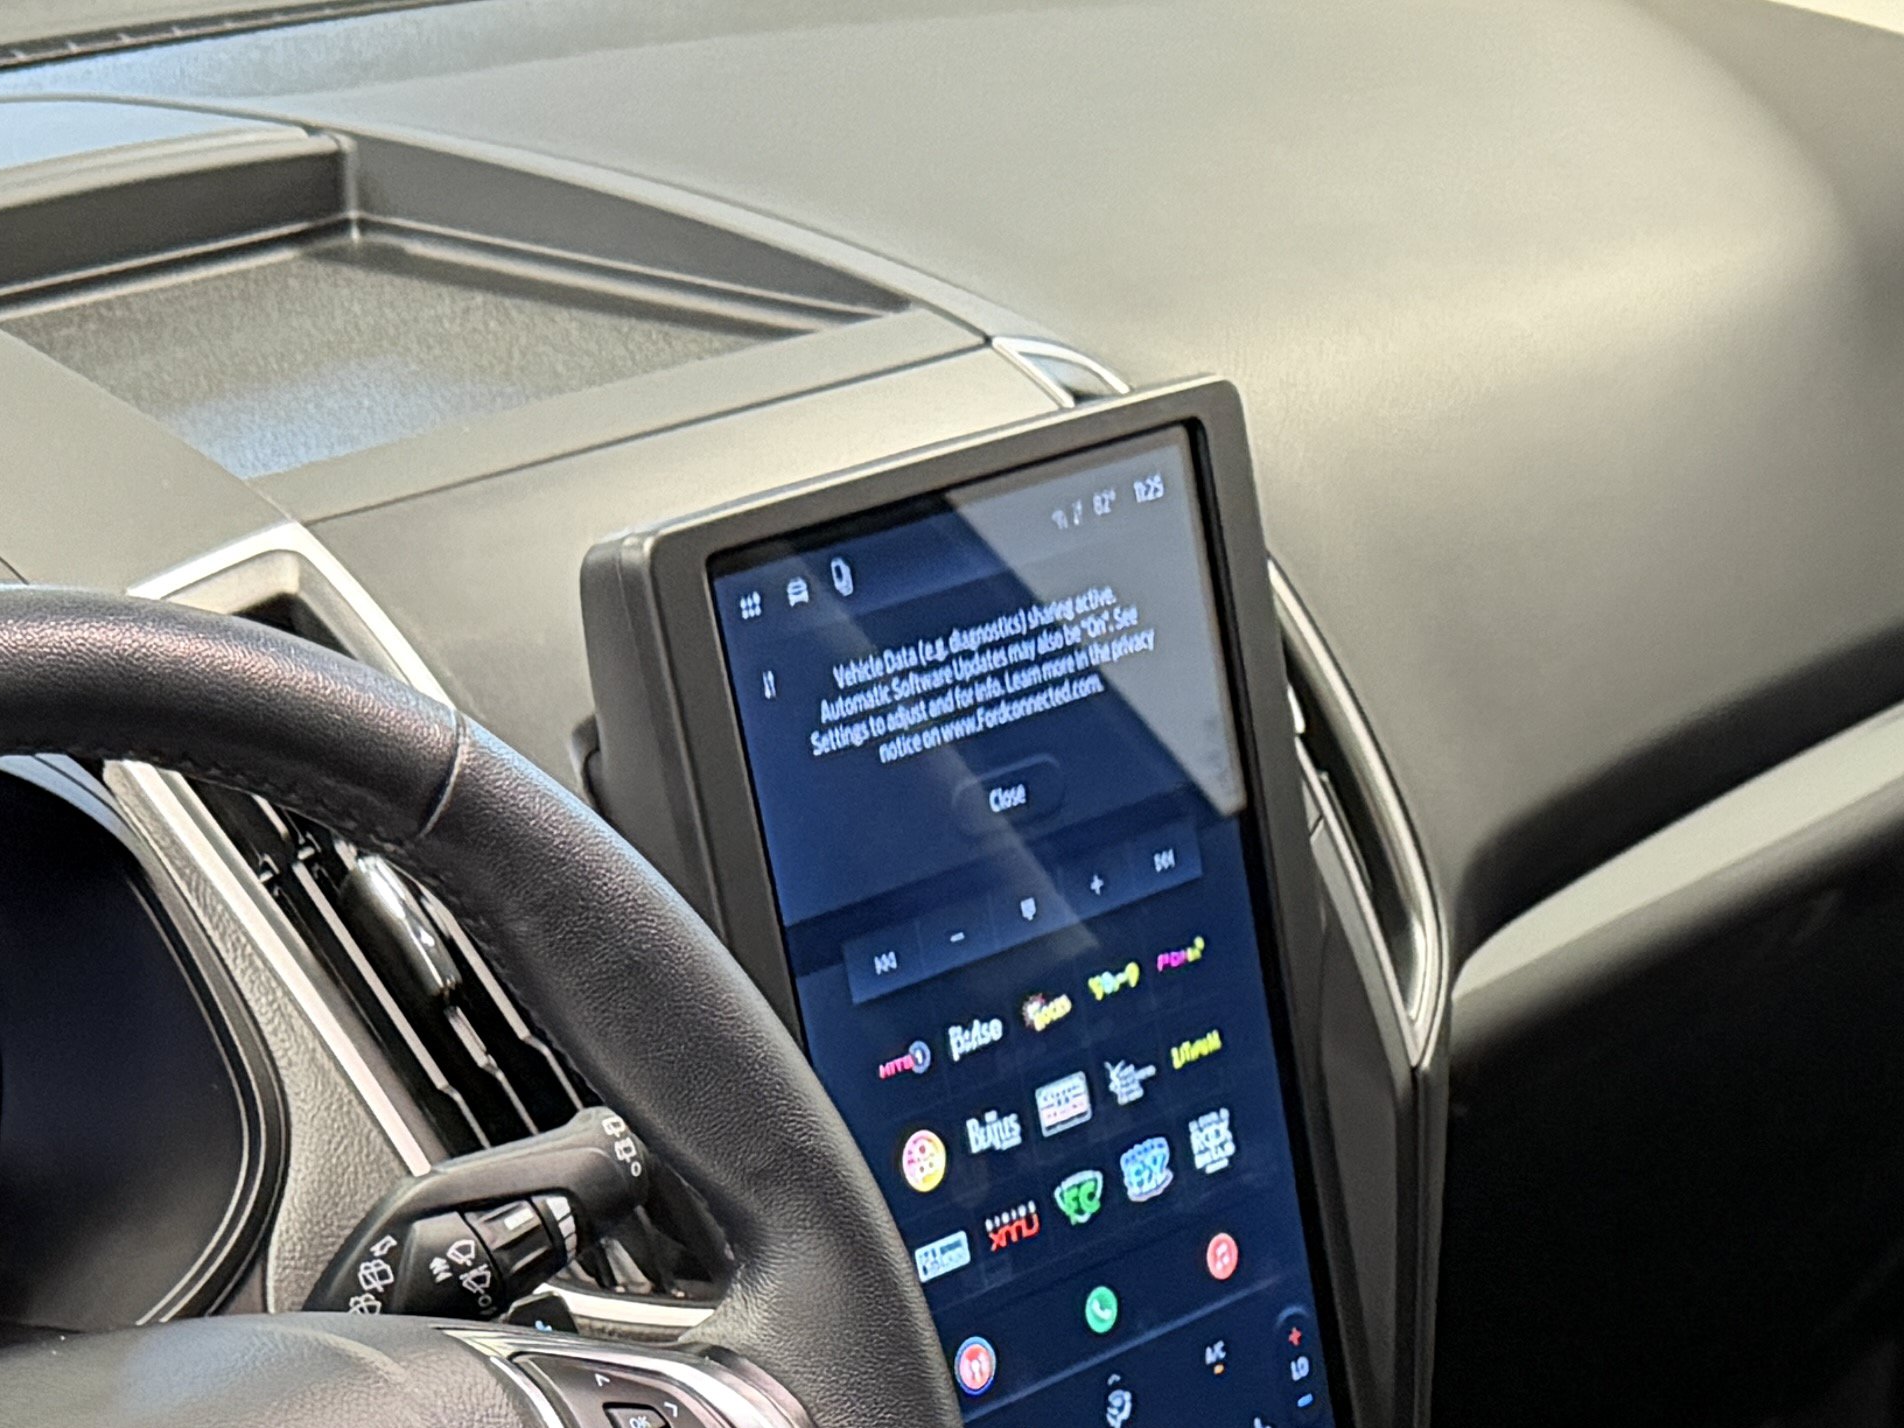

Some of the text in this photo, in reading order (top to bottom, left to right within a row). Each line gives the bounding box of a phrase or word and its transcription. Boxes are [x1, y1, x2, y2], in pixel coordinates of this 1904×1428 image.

[821, 687, 892, 724] Automatic
[892, 662, 953, 701] Software
[952, 646, 1008, 685] Updates
[1008, 638, 1037, 666] may
[1037, 627, 1064, 656] also
[1063, 621, 1081, 645] be
[1114, 604, 1138, 632] See
[833, 653, 883, 690] Vehicle
[883, 644, 917, 675] Data
[949, 608, 1028, 652] diagnostics)
[811, 719, 870, 757] Settings
[869, 714, 885, 737] to
[886, 699, 928, 733] adjust
[929, 691, 954, 720] and
[954, 685, 975, 712] for
[1004, 663, 1042, 695] Learn
[1042, 655, 1074, 684] more
[1074, 648, 1088, 673] in
[1088, 638, 1111, 667] the
[1111, 628, 1154, 664] privacy
[880, 730, 922, 764] notice
[923, 724, 941, 747] on
[989, 784, 1026, 812] Close
[1290, 1356, 1310, 1381] LO
